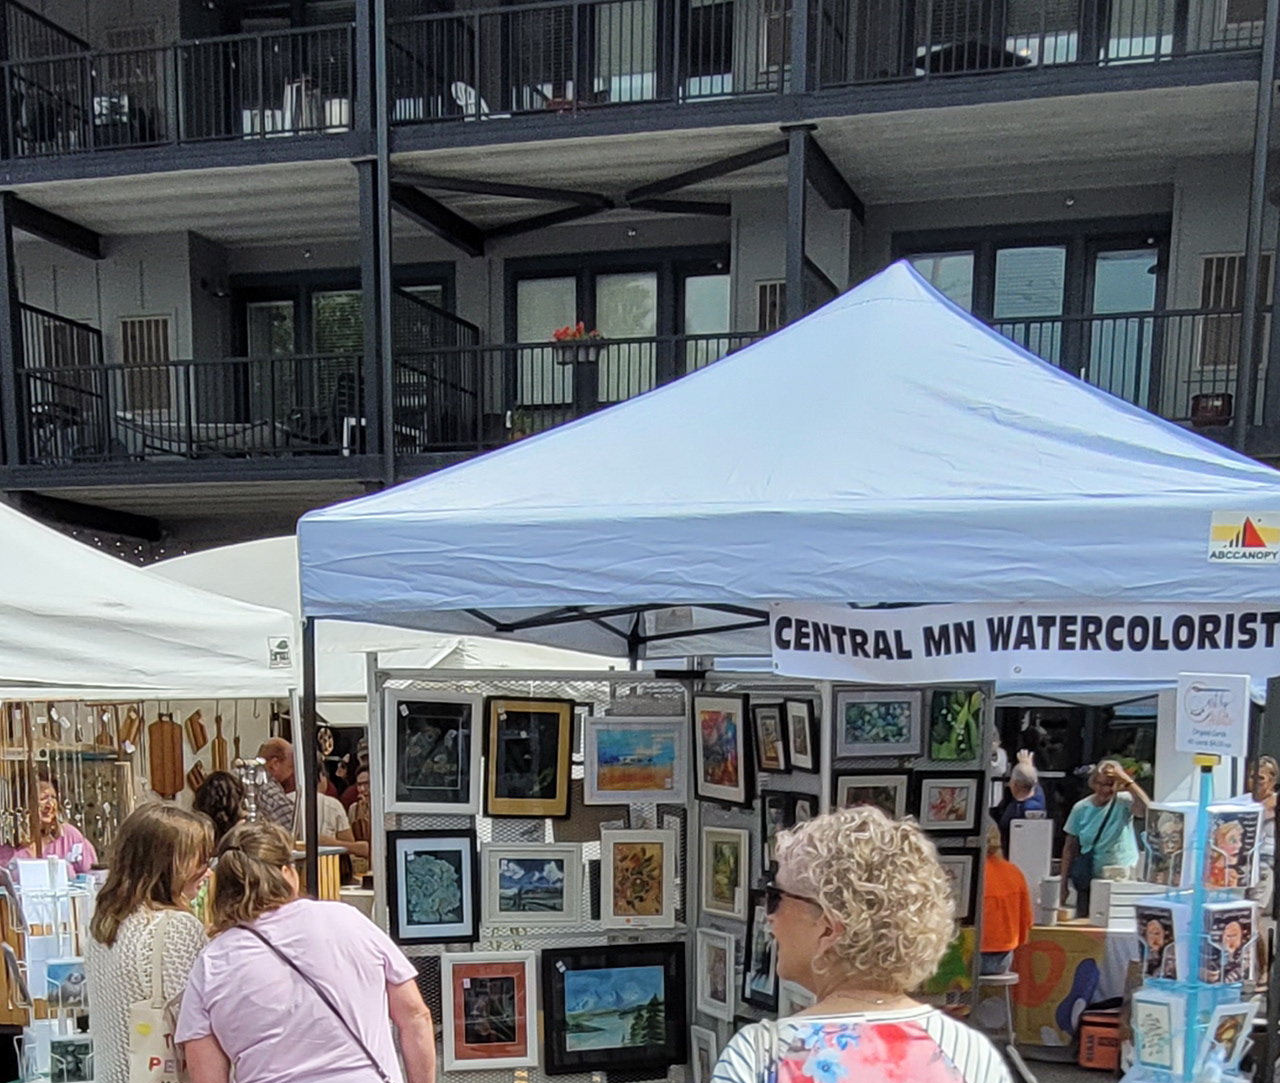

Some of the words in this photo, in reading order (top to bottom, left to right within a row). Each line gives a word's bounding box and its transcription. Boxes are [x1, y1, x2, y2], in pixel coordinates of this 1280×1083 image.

[1209, 550, 1279, 560] ABCCANOPY
[774, 616, 913, 660] CENTRAL
[922, 620, 977, 658] MN
